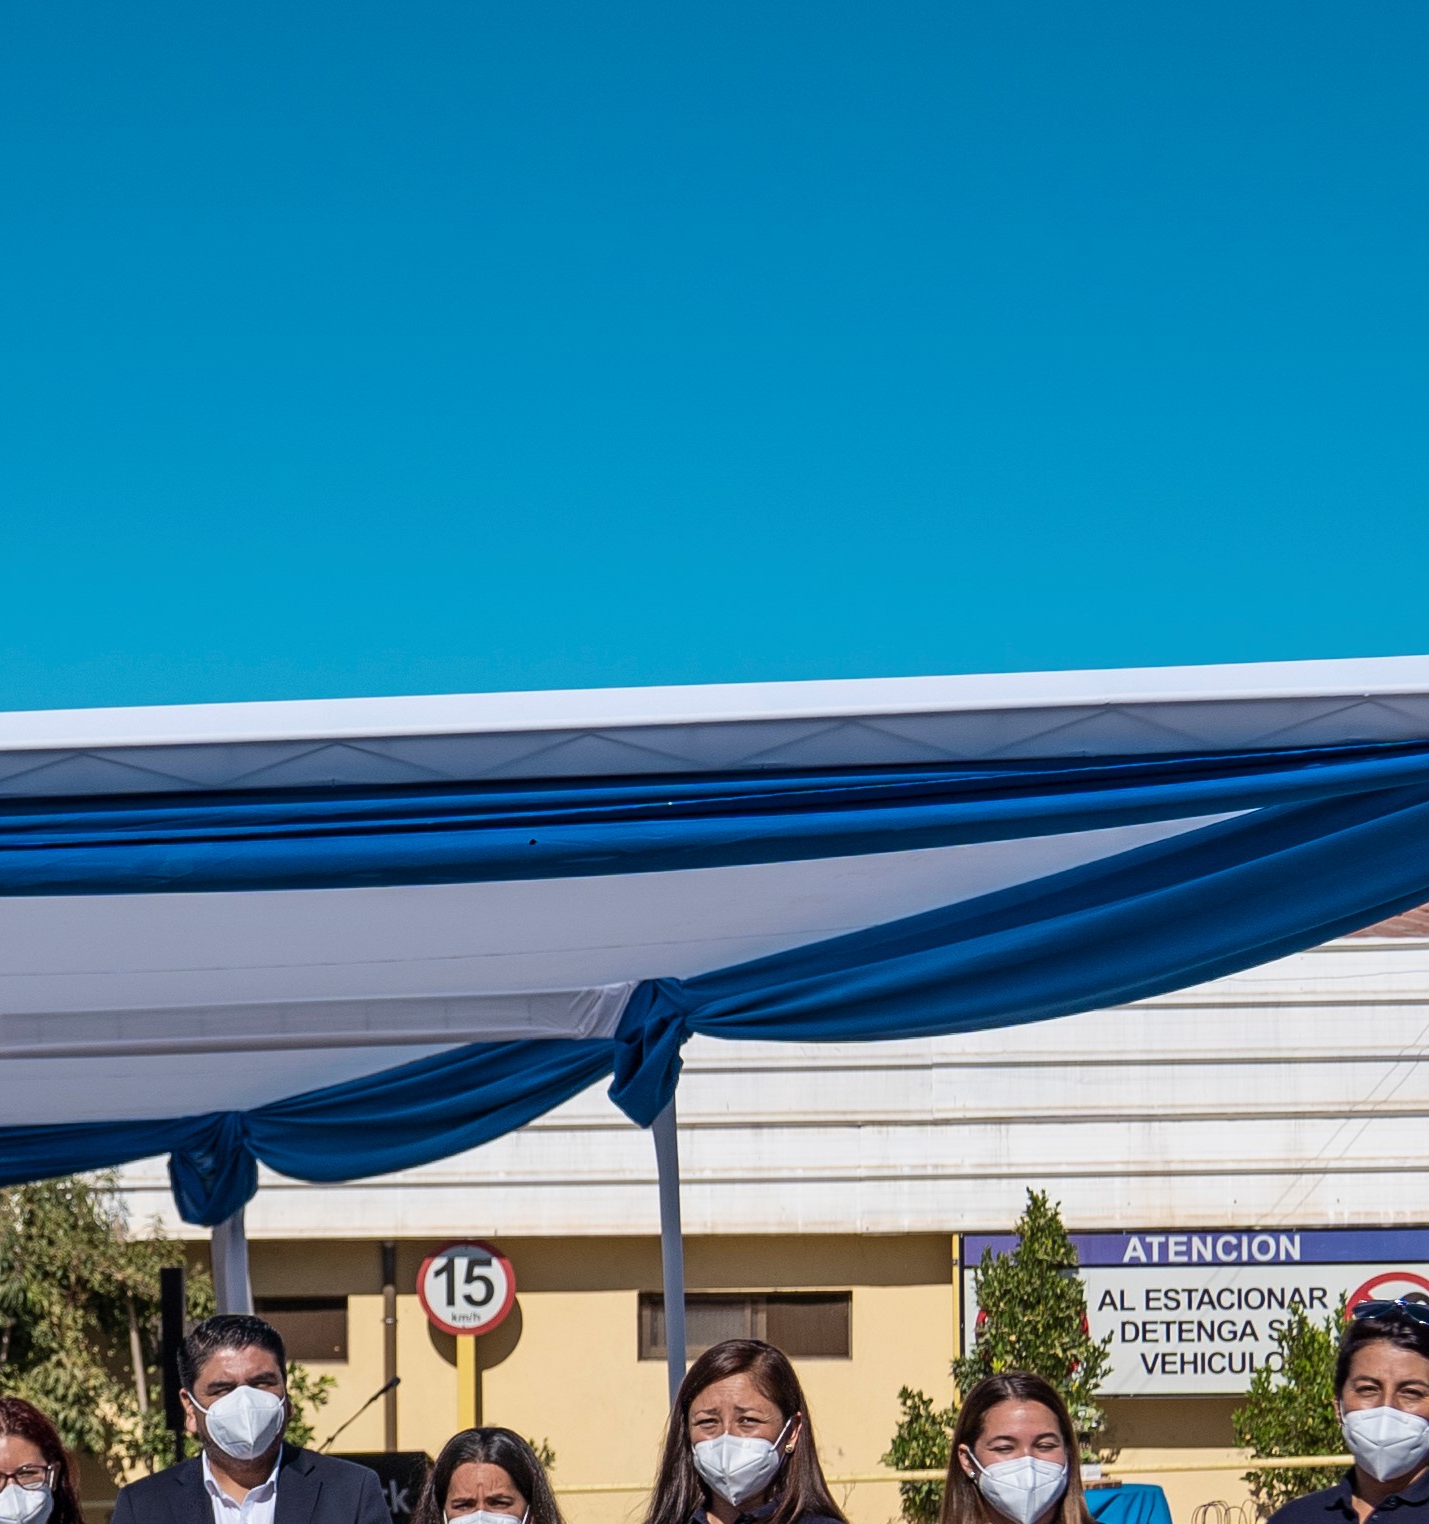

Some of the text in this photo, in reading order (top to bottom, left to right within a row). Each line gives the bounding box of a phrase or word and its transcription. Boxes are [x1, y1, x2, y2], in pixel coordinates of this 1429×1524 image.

[1122, 1235, 1302, 1263] ATENCION
[433, 1255, 495, 1307] 15
[1098, 1287, 1328, 1312] AL ESTACIONAR
[451, 1312, 482, 1323] km/h
[1121, 1320, 1260, 1343] DETENGA
[1141, 1351, 1285, 1374] VEHICULO
